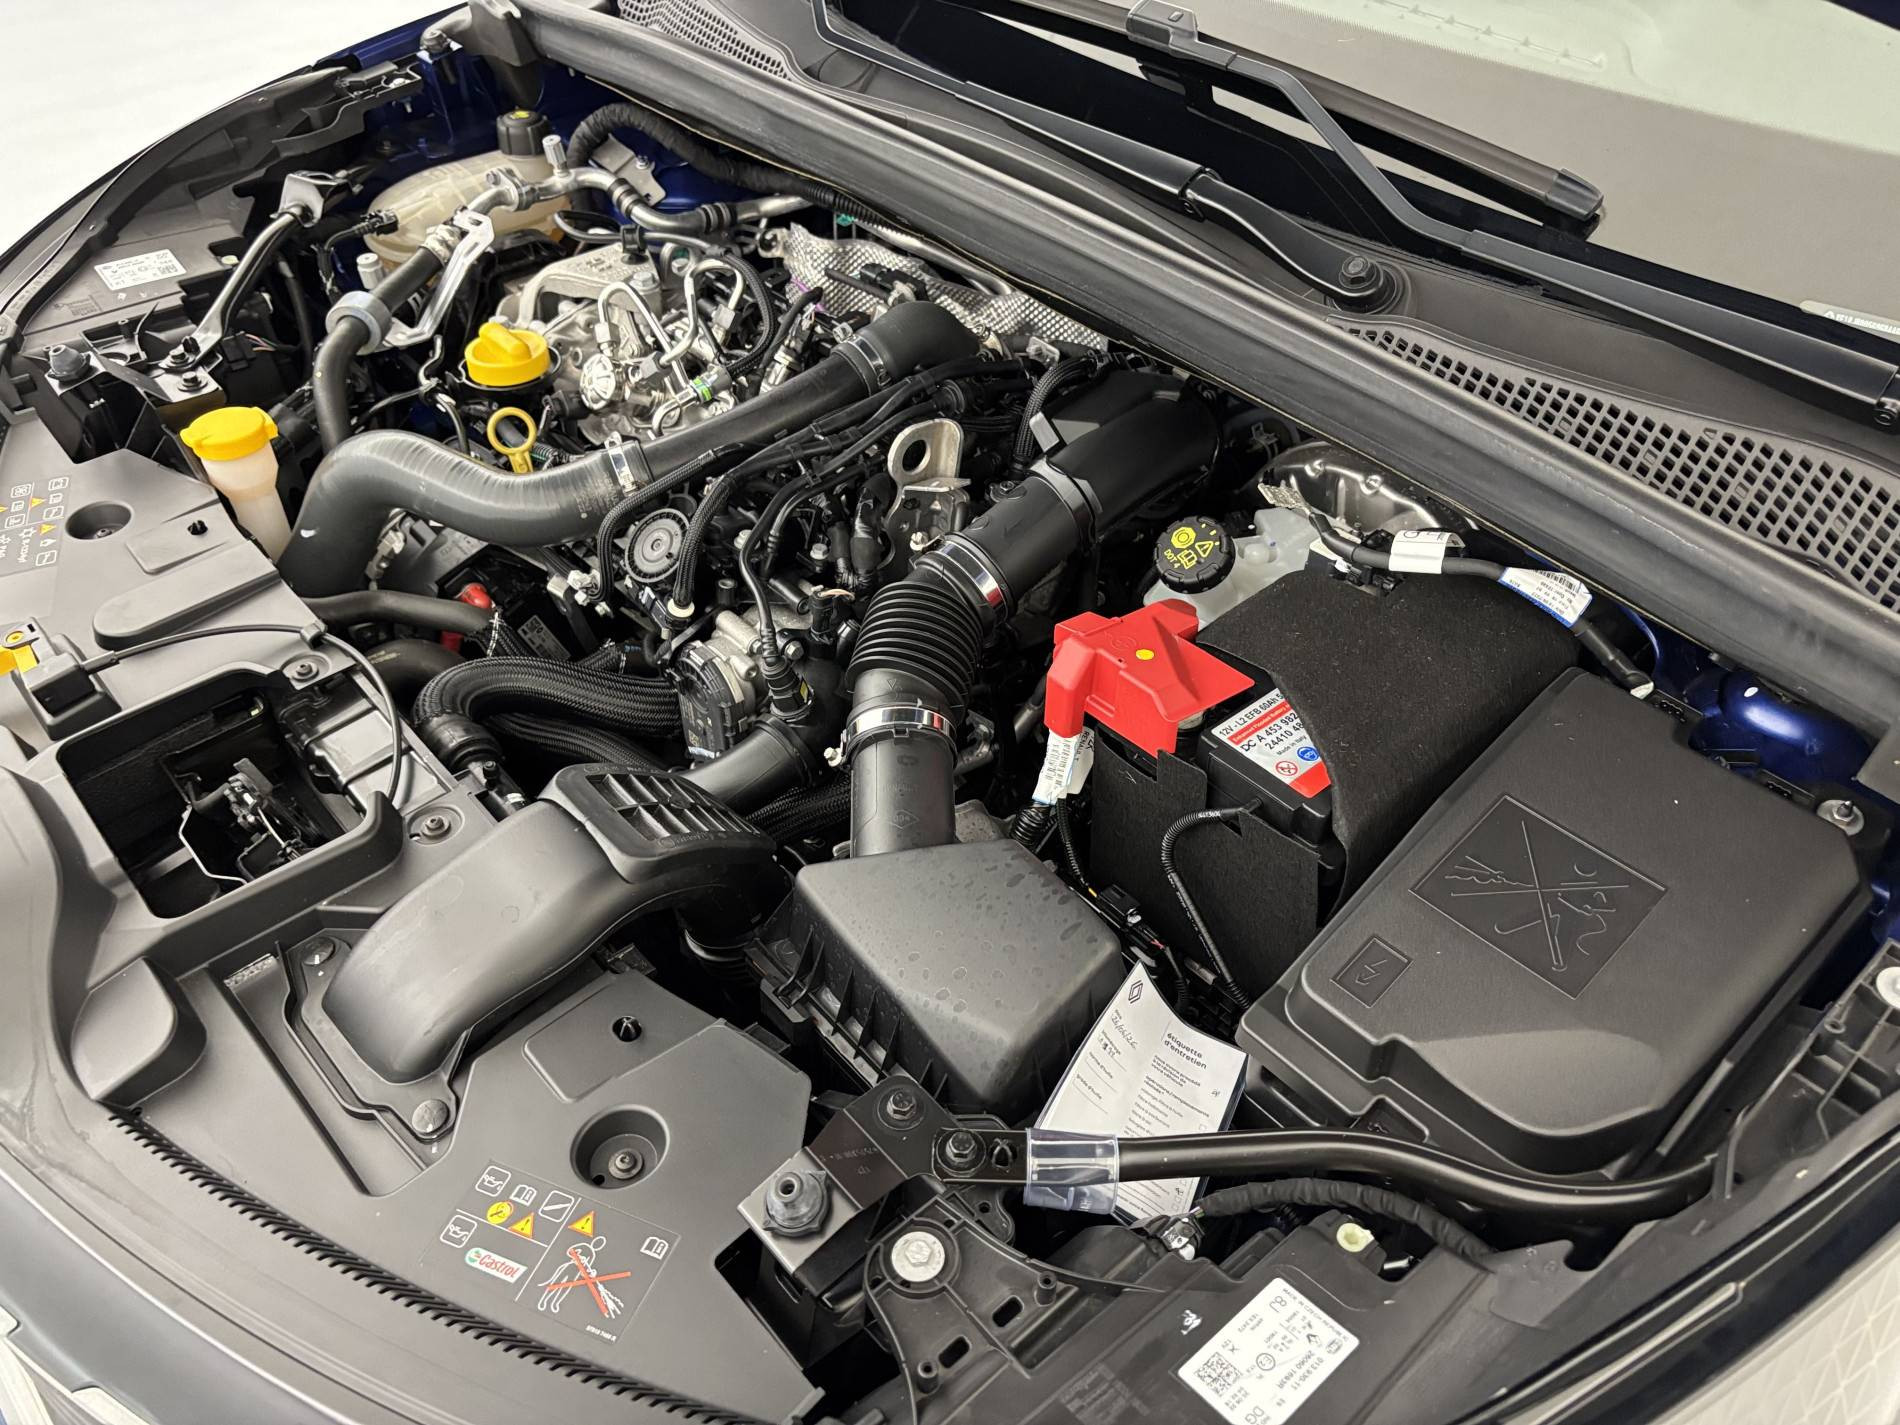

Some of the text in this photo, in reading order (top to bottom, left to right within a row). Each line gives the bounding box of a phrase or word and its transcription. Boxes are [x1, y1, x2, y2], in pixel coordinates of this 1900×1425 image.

[1163, 547, 1177, 563] DOT
[1219, 725, 1233, 737] 12V
[1236, 717, 1247, 726] L2
[1245, 709, 1262, 720] EFB
[1259, 697, 1278, 711] 60Ah
[1265, 723, 1282, 736] 453
[1280, 712, 1298, 726] 982
[1265, 730, 1293, 750] 24410
[1277, 746, 1291, 756] Made
[1164, 1039, 1208, 1070] d'entretien
[1167, 1032, 1203, 1059] étiquette
[478, 1253, 522, 1279] Castrol
